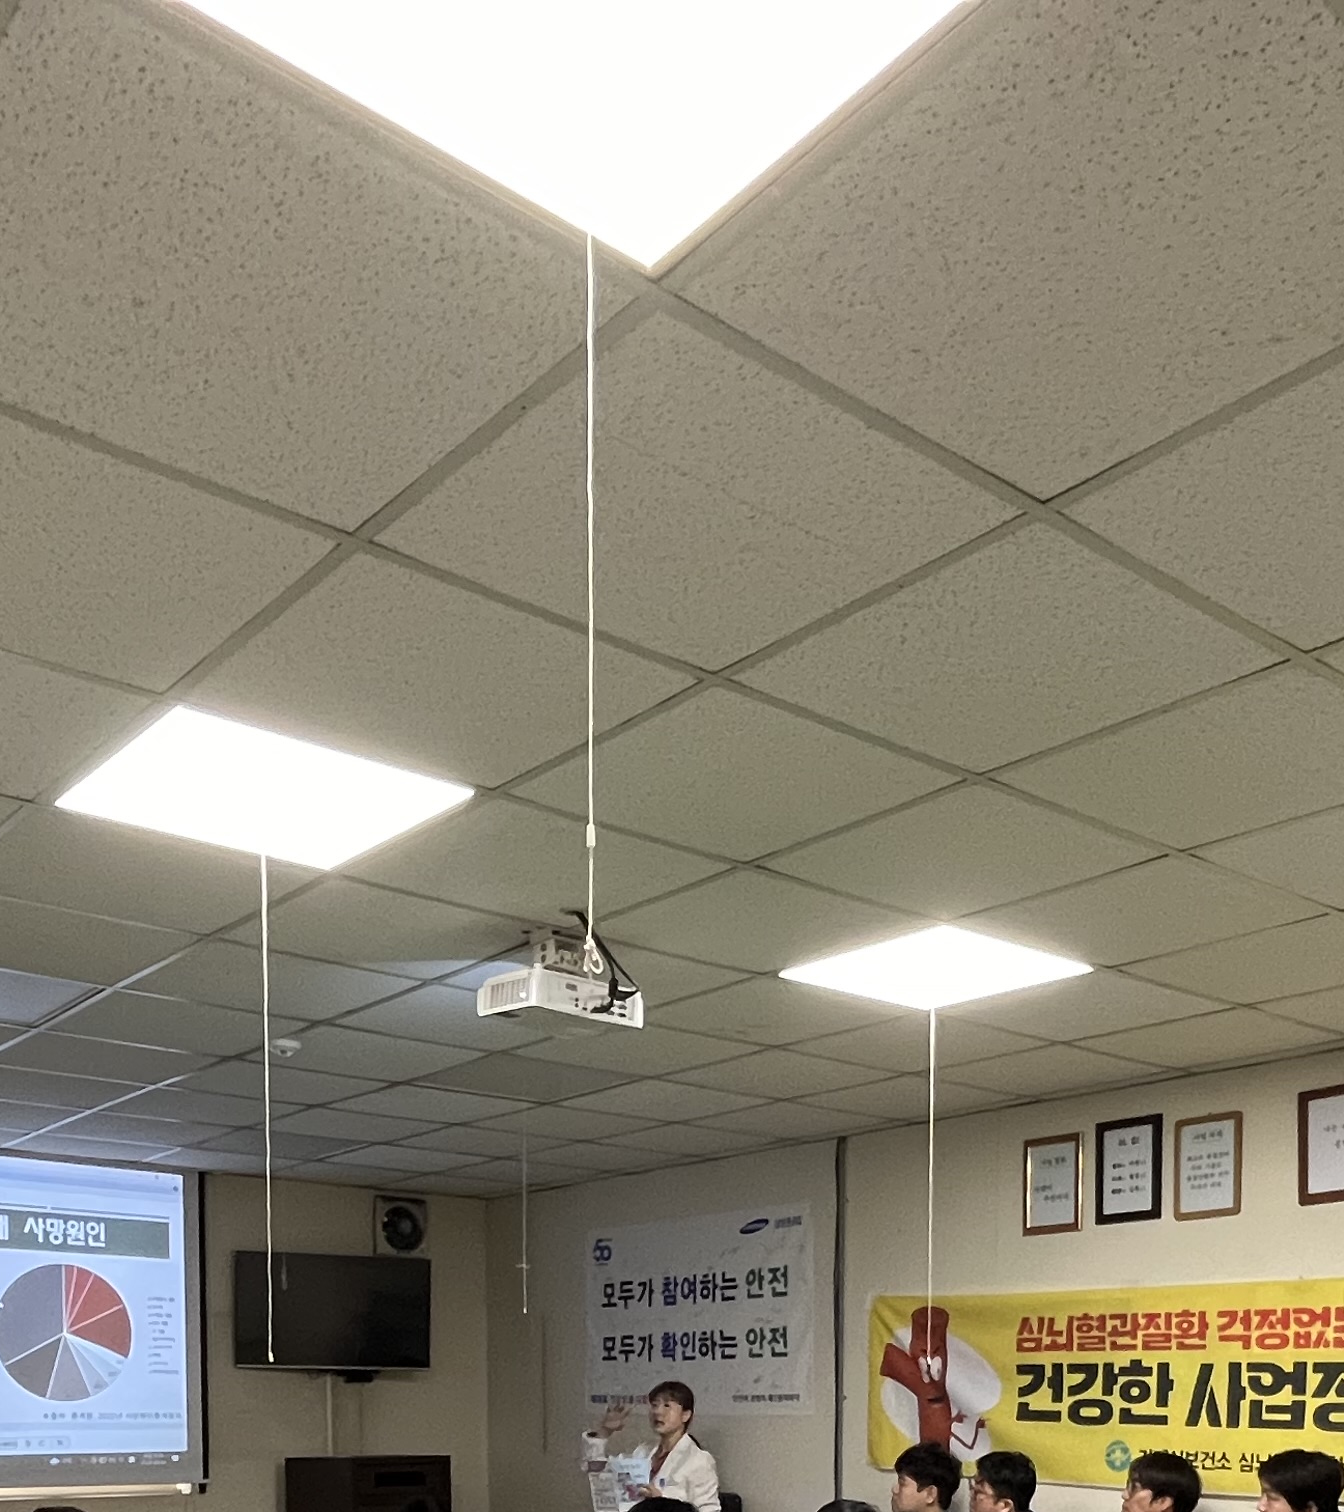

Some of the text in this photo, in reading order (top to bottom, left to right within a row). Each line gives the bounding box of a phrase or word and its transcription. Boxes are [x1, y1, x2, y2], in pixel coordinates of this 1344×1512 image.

[23, 1216, 106, 1248] 사망원인
[601, 1265, 789, 1309] 모두가 참여하는 안전
[601, 1326, 789, 1362] 모두가 확인하는 안전
[1016, 1308, 1209, 1352] 심뇌혈관질환
[1016, 1359, 1174, 1426] 건강한
